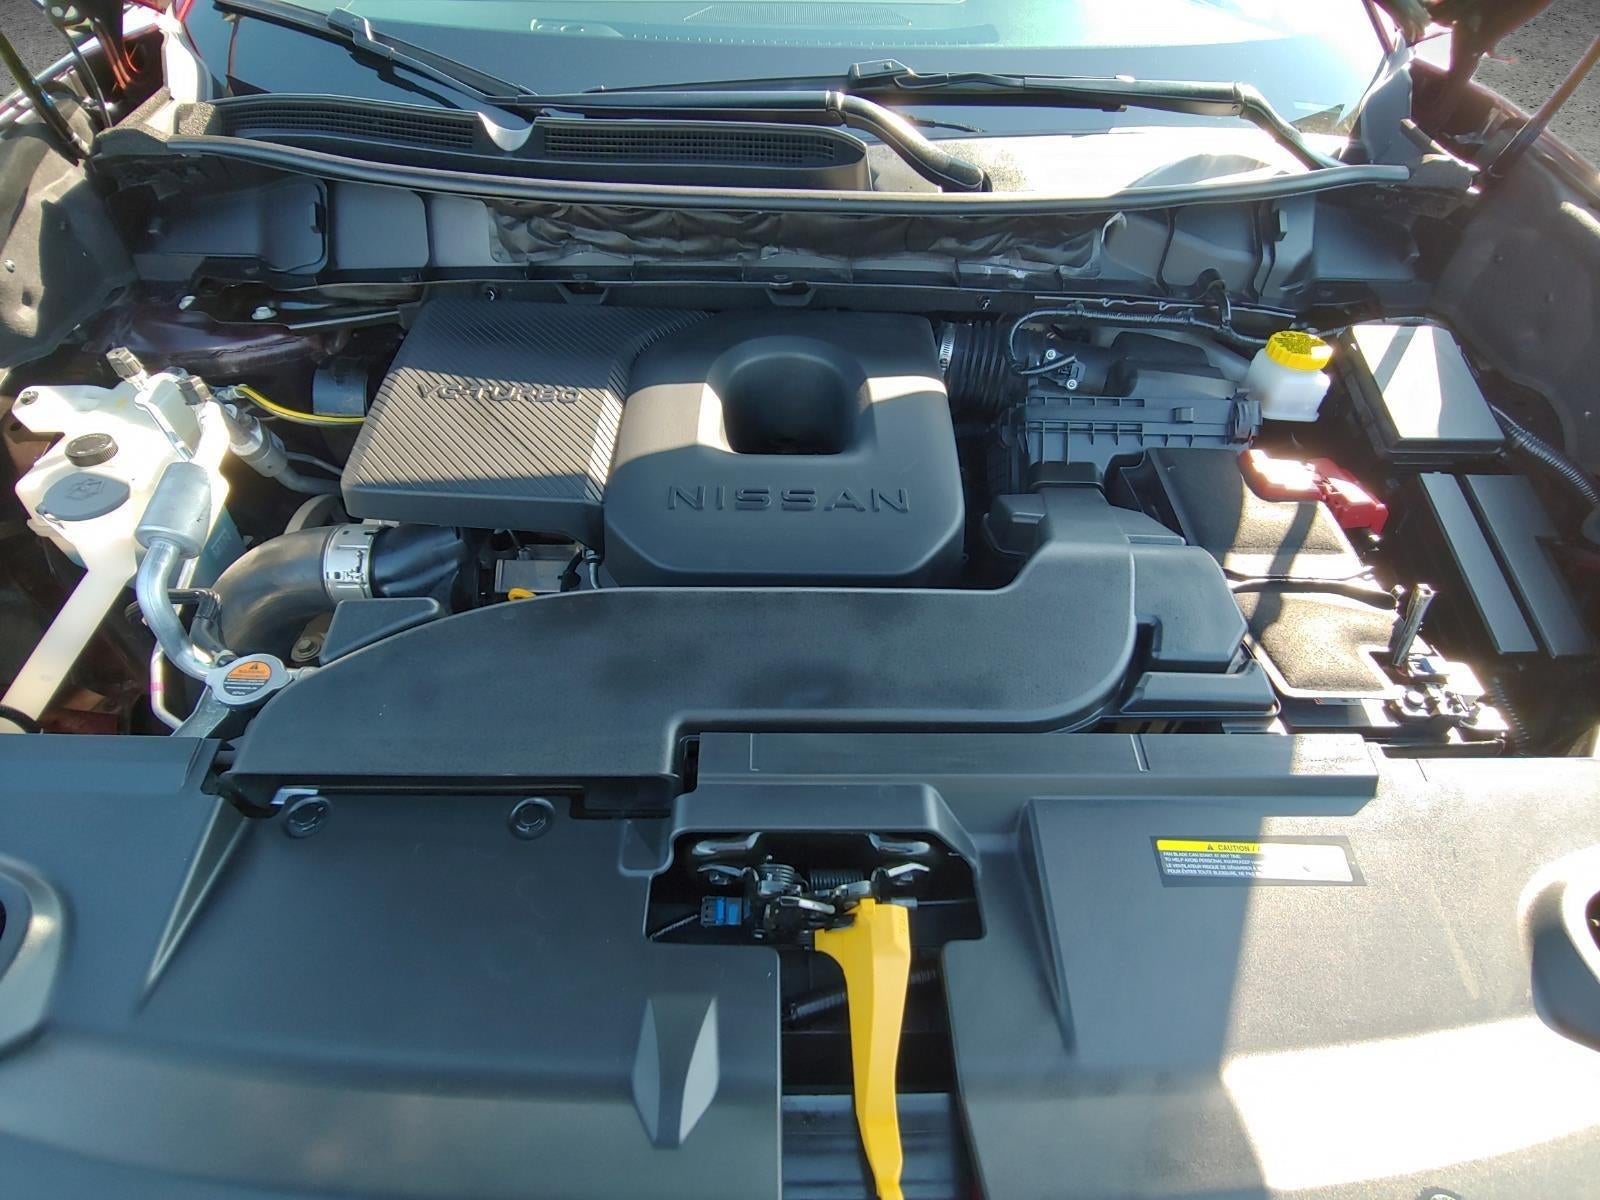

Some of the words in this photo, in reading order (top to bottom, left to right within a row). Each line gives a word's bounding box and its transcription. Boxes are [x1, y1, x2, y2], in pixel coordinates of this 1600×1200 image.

[417, 383, 582, 404] VC-TURBO
[667, 485, 910, 513] NISSAN
[1217, 844, 1250, 852] CAUTION
